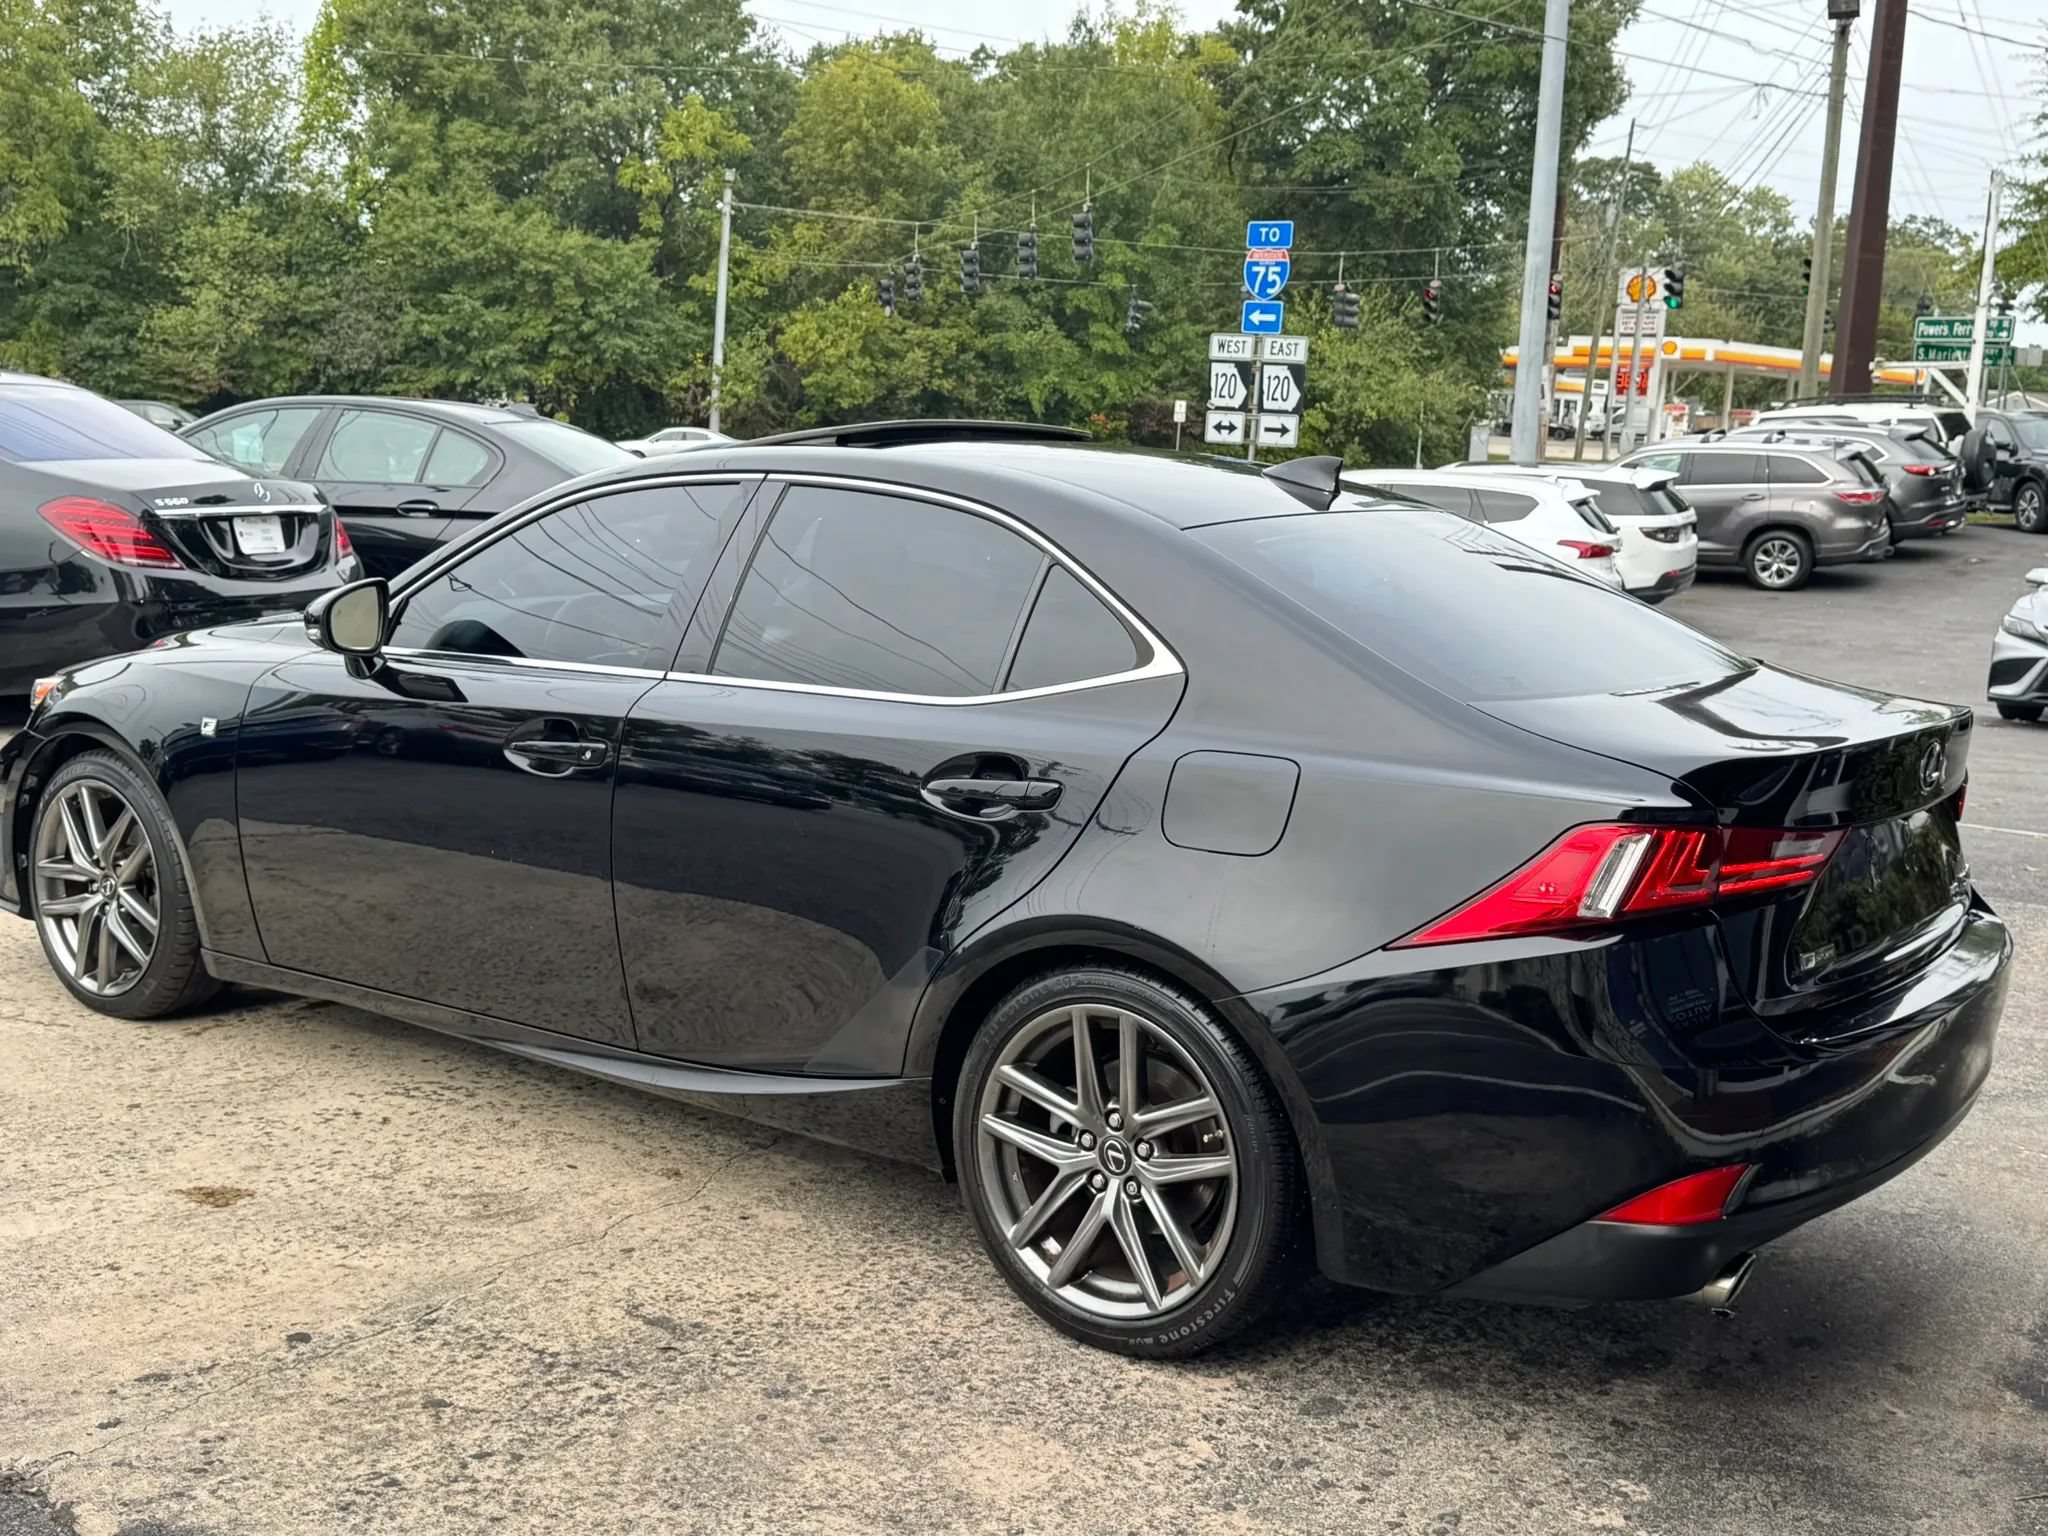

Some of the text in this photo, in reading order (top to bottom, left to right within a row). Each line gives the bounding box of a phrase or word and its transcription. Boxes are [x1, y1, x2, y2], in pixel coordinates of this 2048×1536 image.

[1258, 227, 1280, 242] TO
[1252, 266, 1281, 294] 75
[1918, 322, 1948, 337] Powers
[1952, 321, 1973, 337] Ferr
[1217, 339, 1247, 354] WEST
[1269, 341, 1299, 357] EAST
[1214, 373, 1237, 399] 120
[1266, 375, 1290, 402] 120
[1159, 1287, 1236, 1344] Firestone
